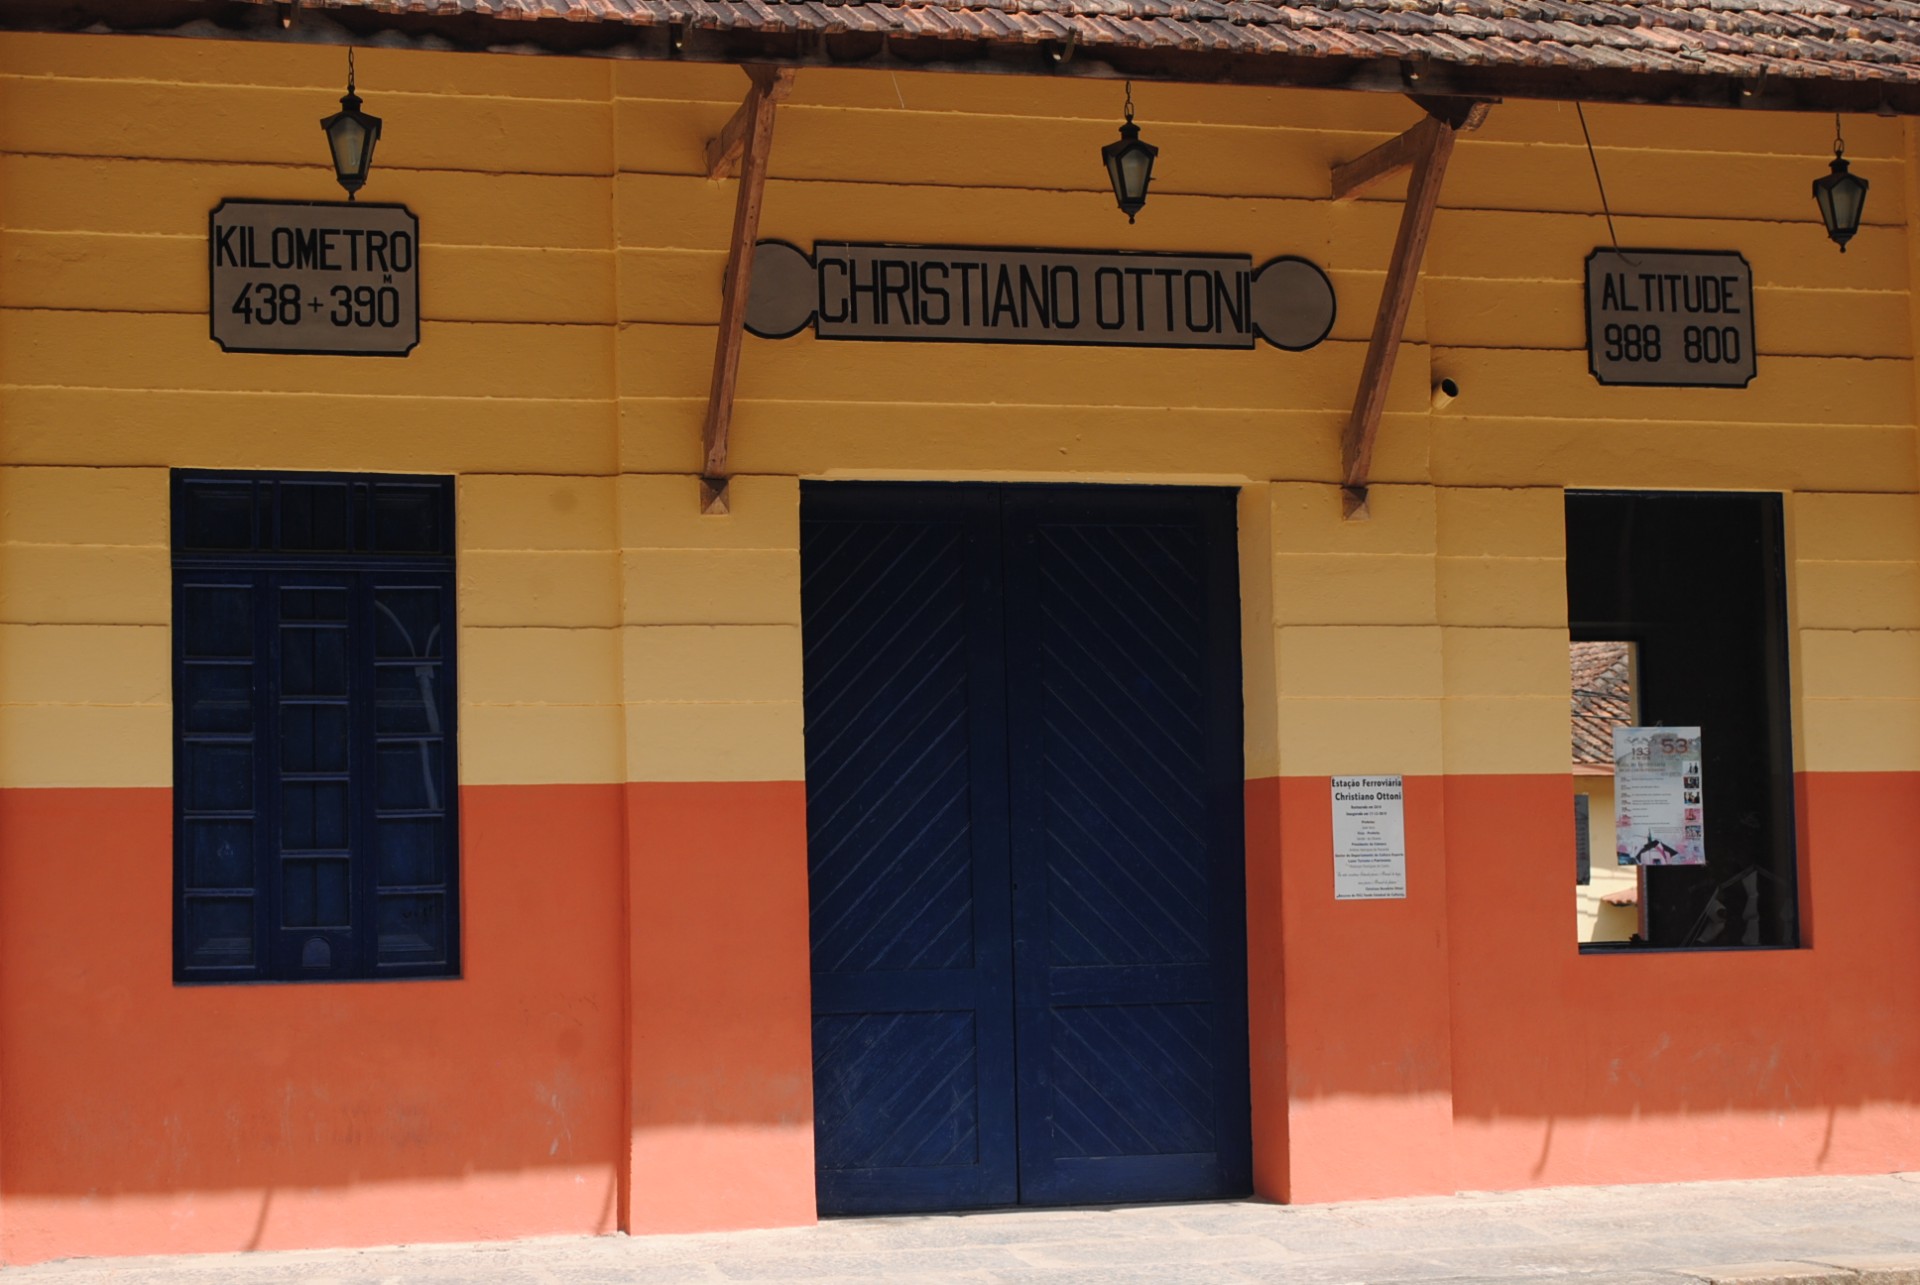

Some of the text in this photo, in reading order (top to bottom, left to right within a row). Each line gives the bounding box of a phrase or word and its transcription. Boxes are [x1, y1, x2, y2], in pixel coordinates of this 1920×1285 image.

[215, 225, 412, 272] KILOMETRO
[817, 257, 1251, 334] CHRISTIANO OTTONI
[1602, 273, 1741, 315] ALTITUDE
[1604, 323, 1741, 364] 988 800
[1331, 778, 1402, 789] Estação Ferroviária
[1335, 791, 1402, 801] Christiano Ottoni
